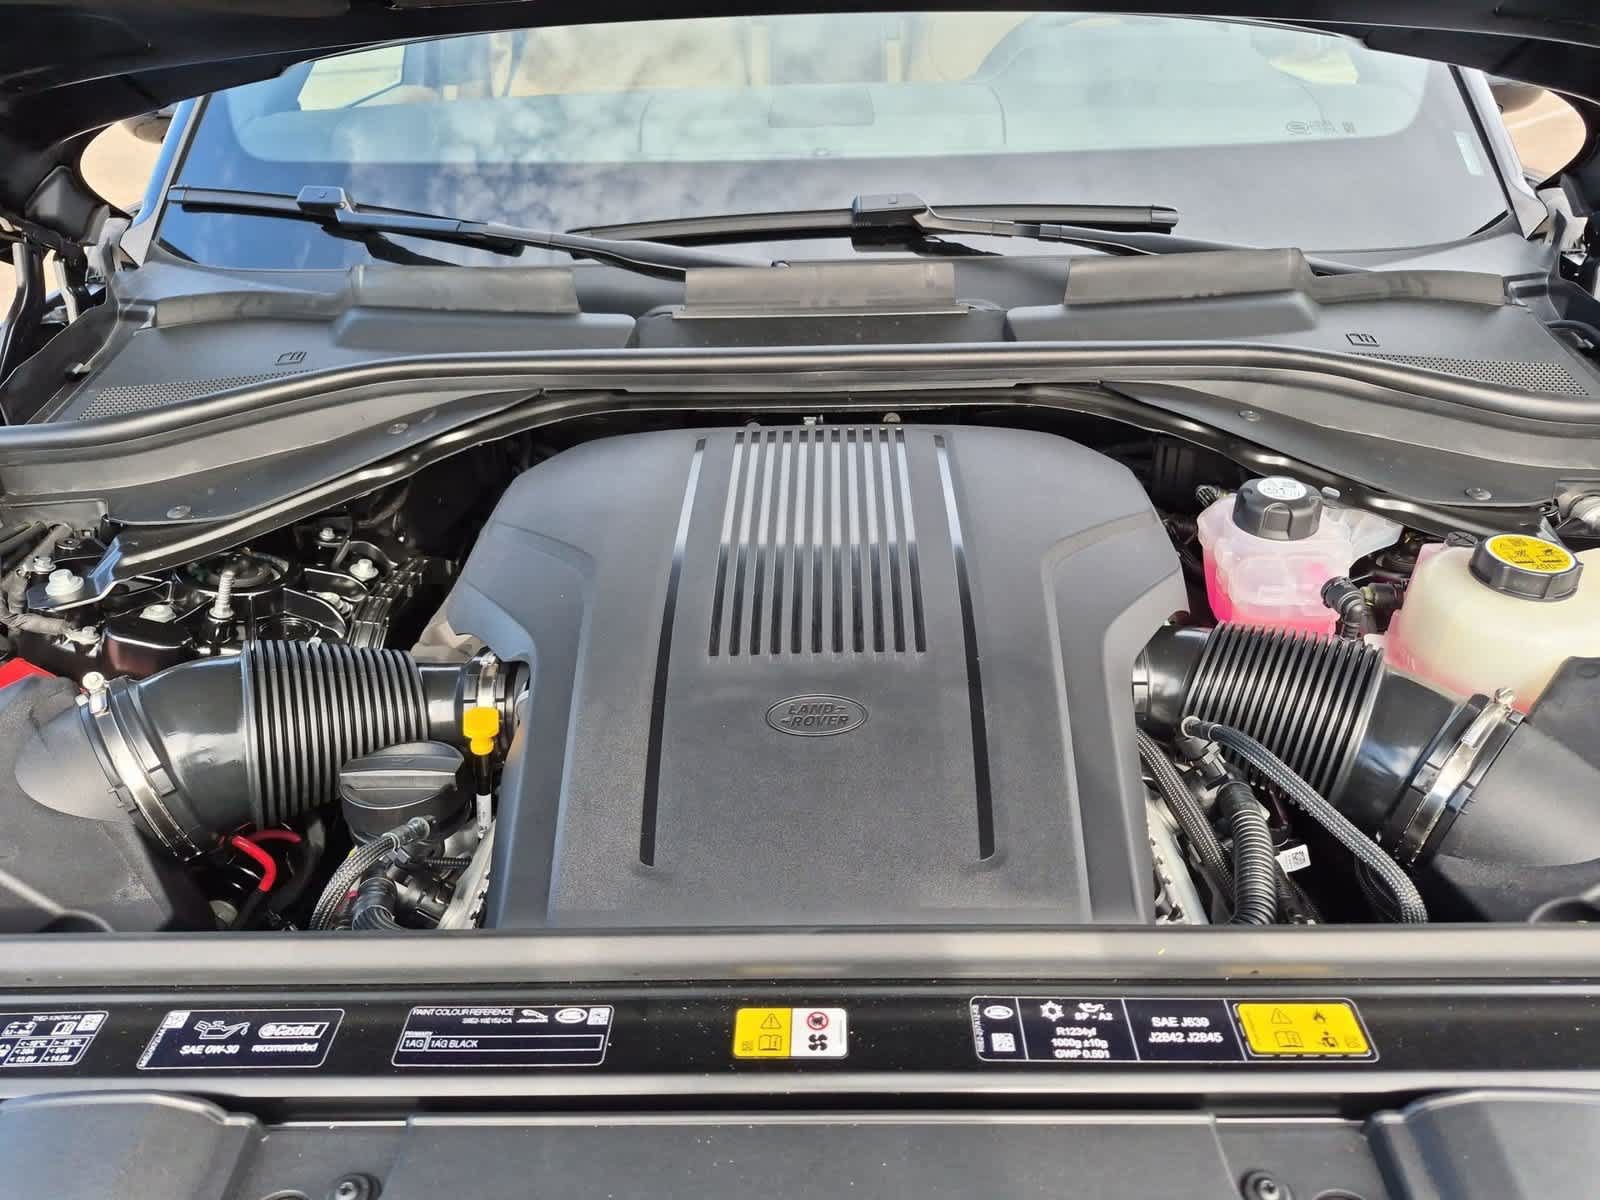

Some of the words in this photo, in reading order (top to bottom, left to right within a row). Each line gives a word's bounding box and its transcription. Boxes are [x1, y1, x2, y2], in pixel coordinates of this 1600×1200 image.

[788, 702, 835, 715] LAND
[791, 714, 849, 727] ROVER
[412, 1008, 436, 1016] PAINT
[434, 1008, 469, 1016] COLOUR
[469, 1008, 516, 1016] REFERENCE
[1151, 1016, 1180, 1028] SAE
[276, 1024, 320, 1036] Castrol
[251, 1042, 319, 1053] recommended
[404, 1039, 425, 1049] 1AG
[430, 1039, 448, 1048] 1AG
[447, 1039, 480, 1048] BLACK
[179, 1044, 206, 1055] SAE
[205, 1044, 241, 1055] 0W-30
[1054, 1049, 1082, 1059] GWP
